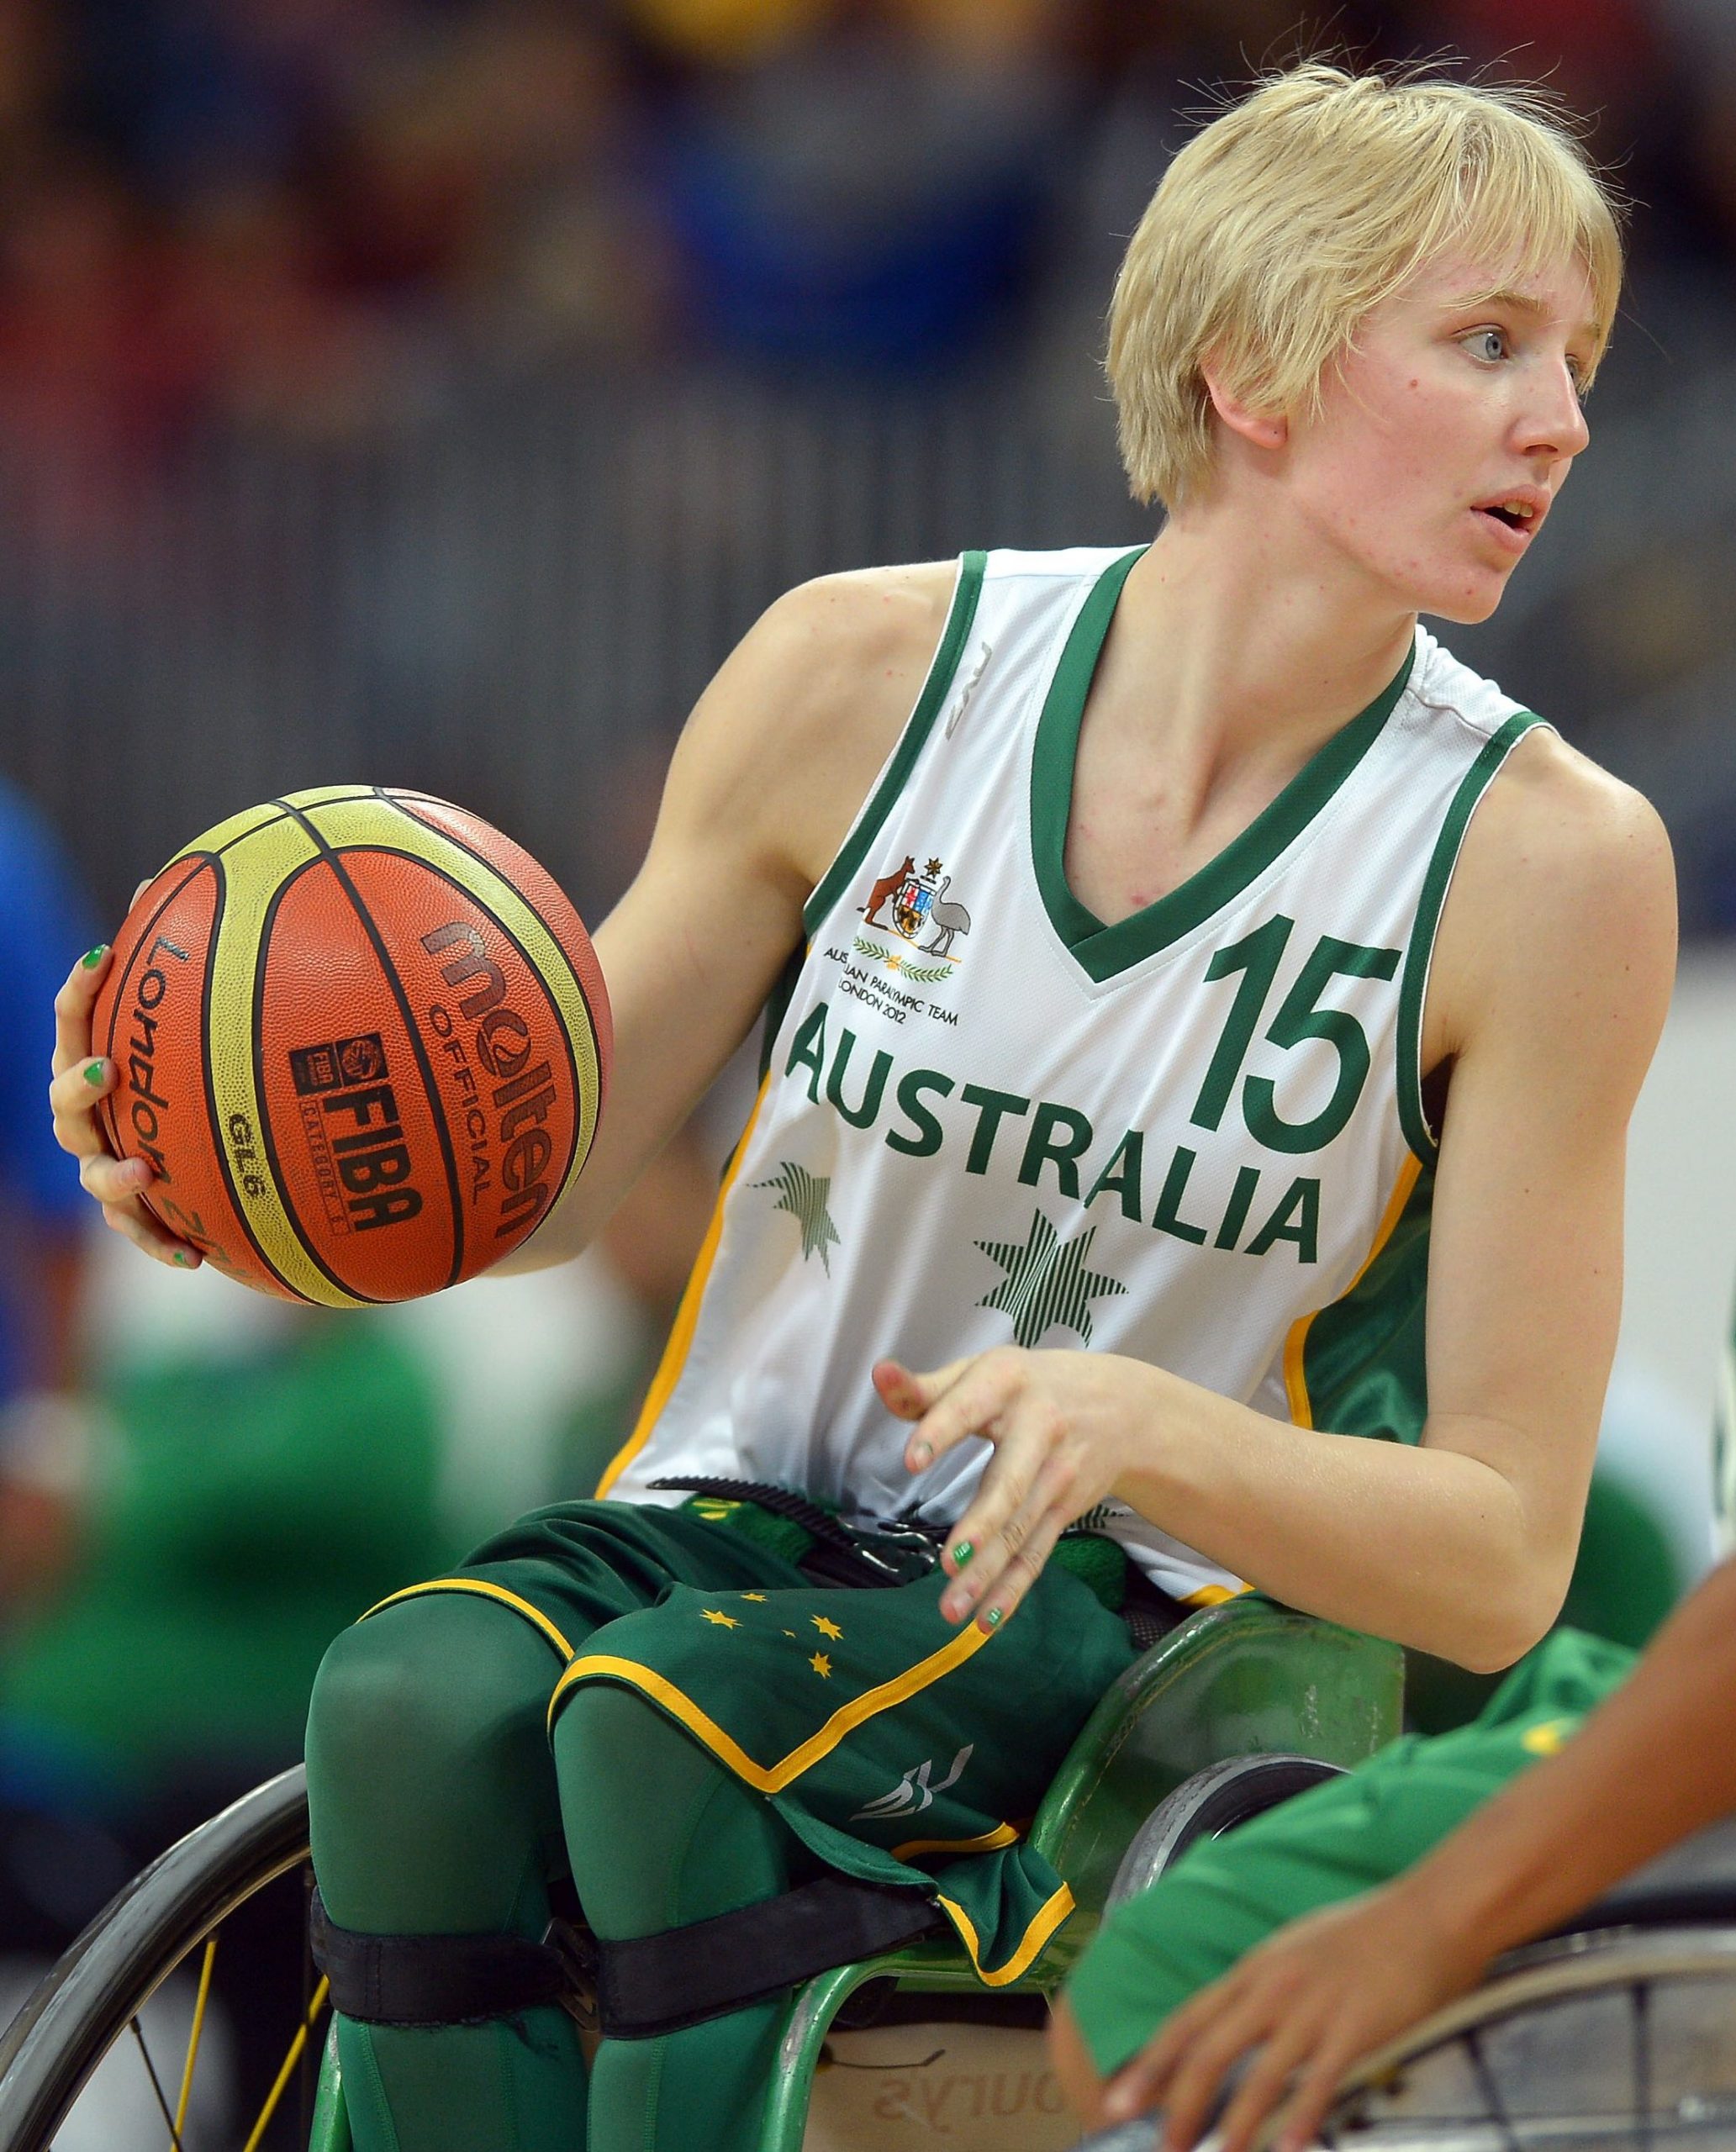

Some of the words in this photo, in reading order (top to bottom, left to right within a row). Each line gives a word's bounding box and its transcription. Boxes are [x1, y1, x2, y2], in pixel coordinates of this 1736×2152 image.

[870, 975, 925, 1013] PARALYMPIC
[927, 1004, 958, 1026] TEAM
[883, 1004, 907, 1025] 2012
[1189, 913, 1403, 1155] 15
[303, 1106, 339, 1199] CATEGORY
[421, 921, 557, 1238] molten
[430, 1005, 493, 1205] OFFICIAL
[784, 1001, 1321, 1264] AUSTRALIA
[229, 1113, 266, 1196] GL6
[323, 1084, 423, 1232] FIBA
